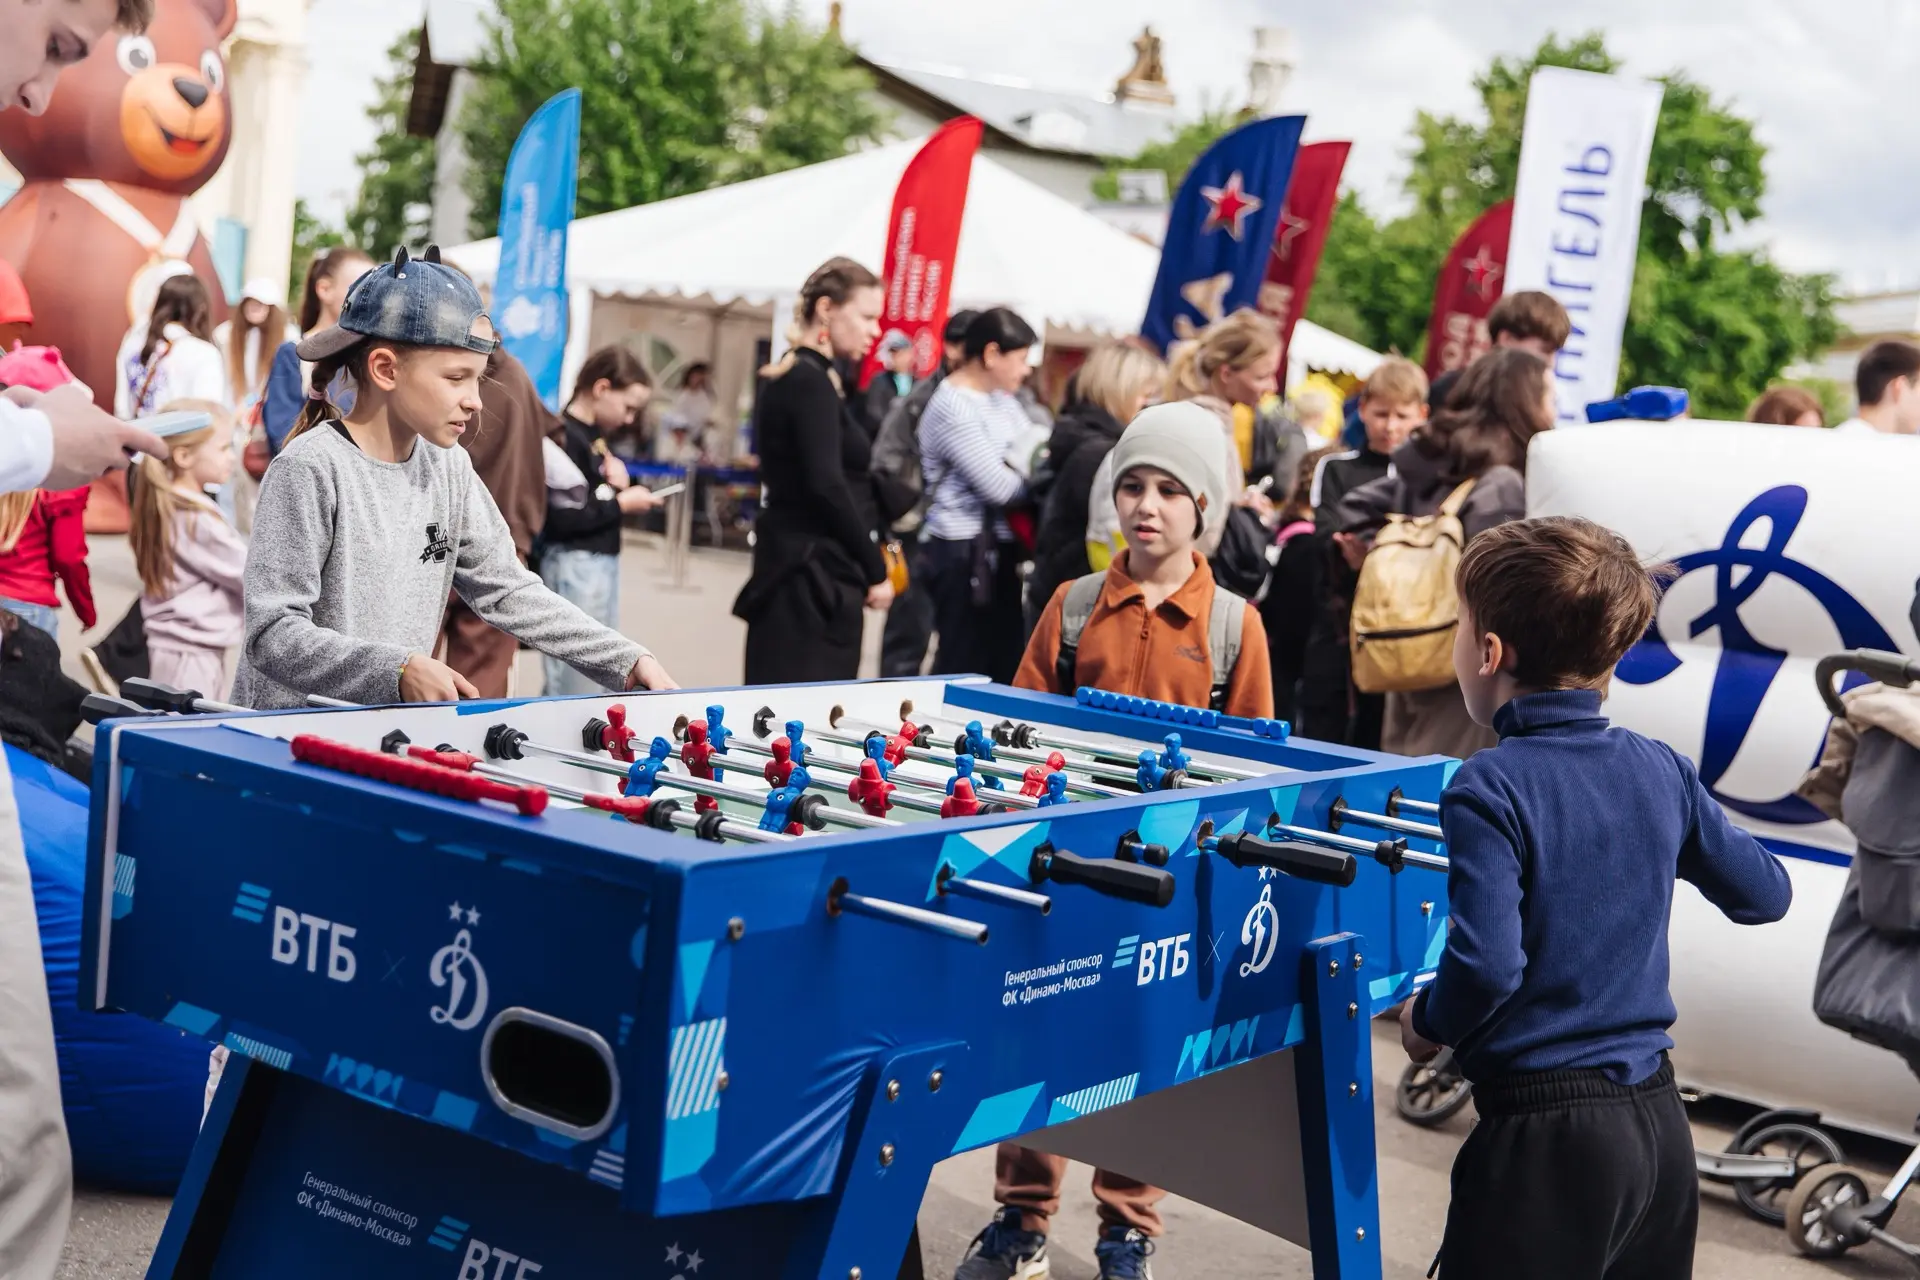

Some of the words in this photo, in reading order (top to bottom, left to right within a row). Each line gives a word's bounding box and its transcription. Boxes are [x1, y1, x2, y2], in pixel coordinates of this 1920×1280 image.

[271, 905, 357, 983] ВТБ
[1004, 959, 1065, 987] Генеральный
[1066, 953, 1103, 973] спонсор
[1136, 932, 1191, 987] ВТБ
[1002, 989, 1018, 1007] ФК
[1019, 973, 1101, 1005] «Динамо-Москва»
[297, 1191, 315, 1208] ФК
[315, 1200, 411, 1246] «Динамо-Москва»
[302, 1171, 373, 1210] Генеральный
[372, 1201, 418, 1231] спонсор
